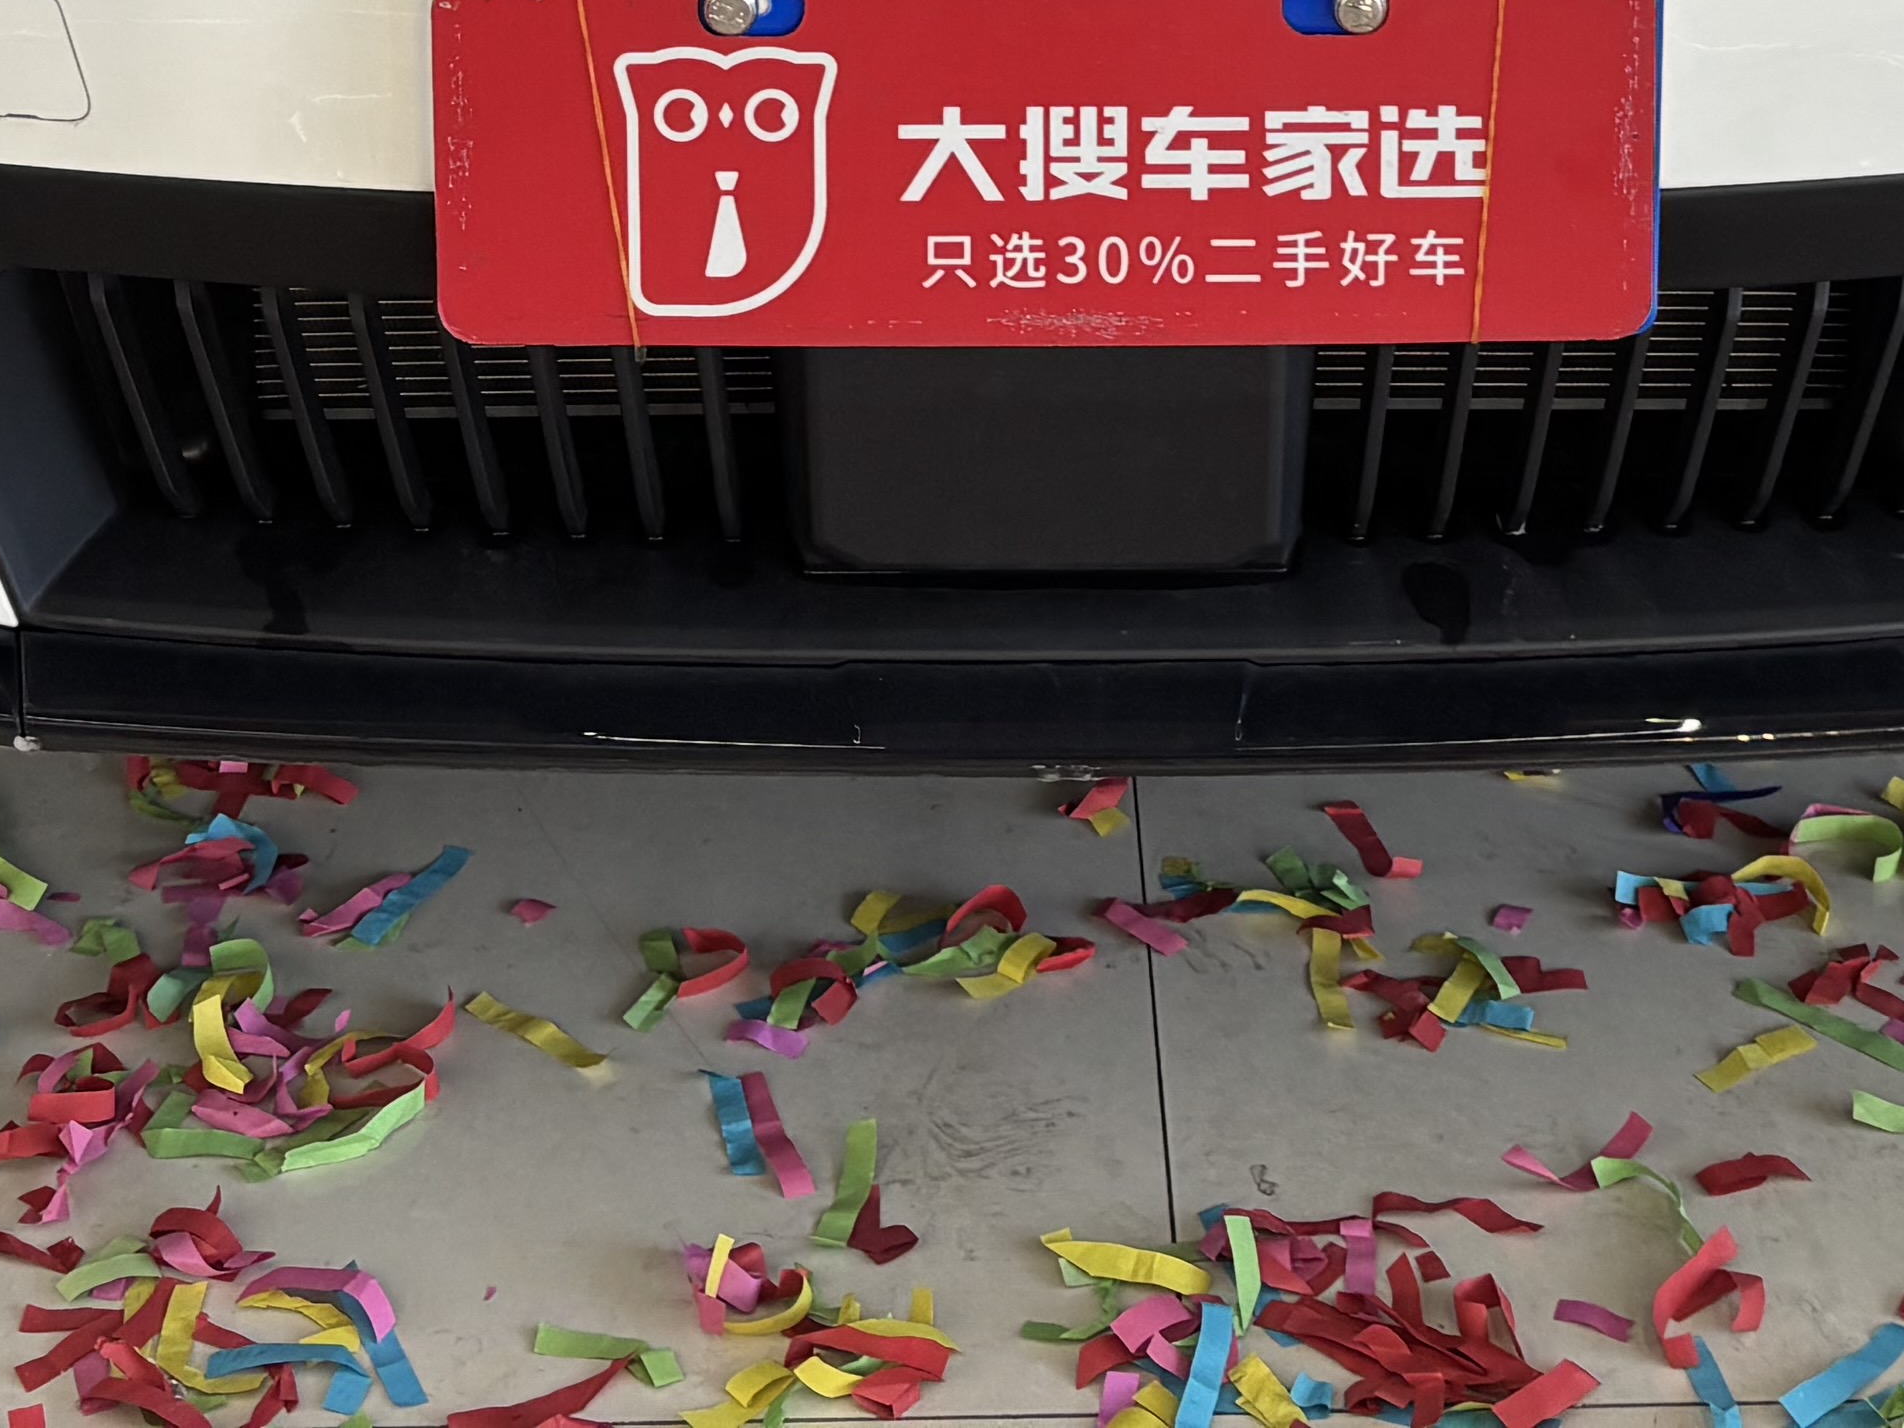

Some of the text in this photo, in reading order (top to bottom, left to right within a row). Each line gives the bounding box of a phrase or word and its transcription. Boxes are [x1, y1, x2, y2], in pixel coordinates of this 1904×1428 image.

[897, 105, 1487, 202] 大搜车家选
[922, 230, 1466, 289] 只选30%二手好车
